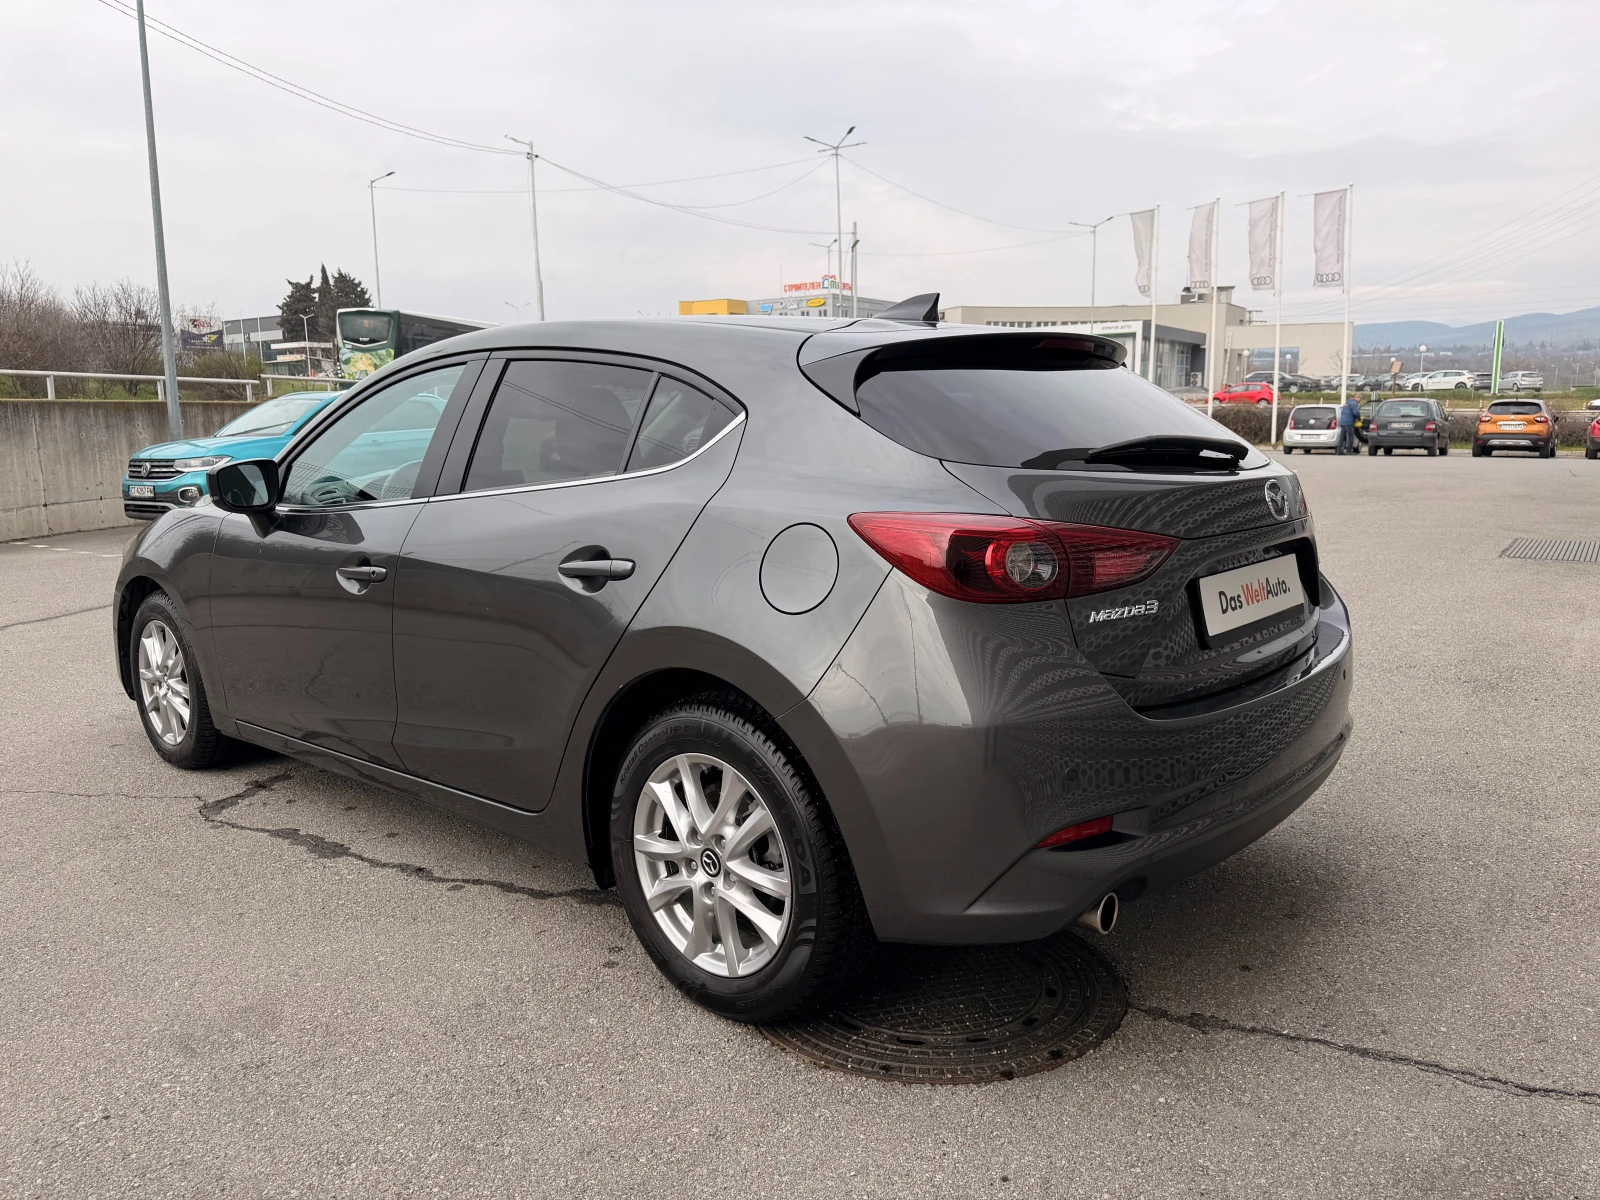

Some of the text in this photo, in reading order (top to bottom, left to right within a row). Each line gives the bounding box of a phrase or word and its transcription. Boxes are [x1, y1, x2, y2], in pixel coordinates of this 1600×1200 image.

[1218, 576, 1291, 615] Das WeltAuto.
[1089, 599, 1159, 623] Mazda3
[637, 727, 669, 754] Control
